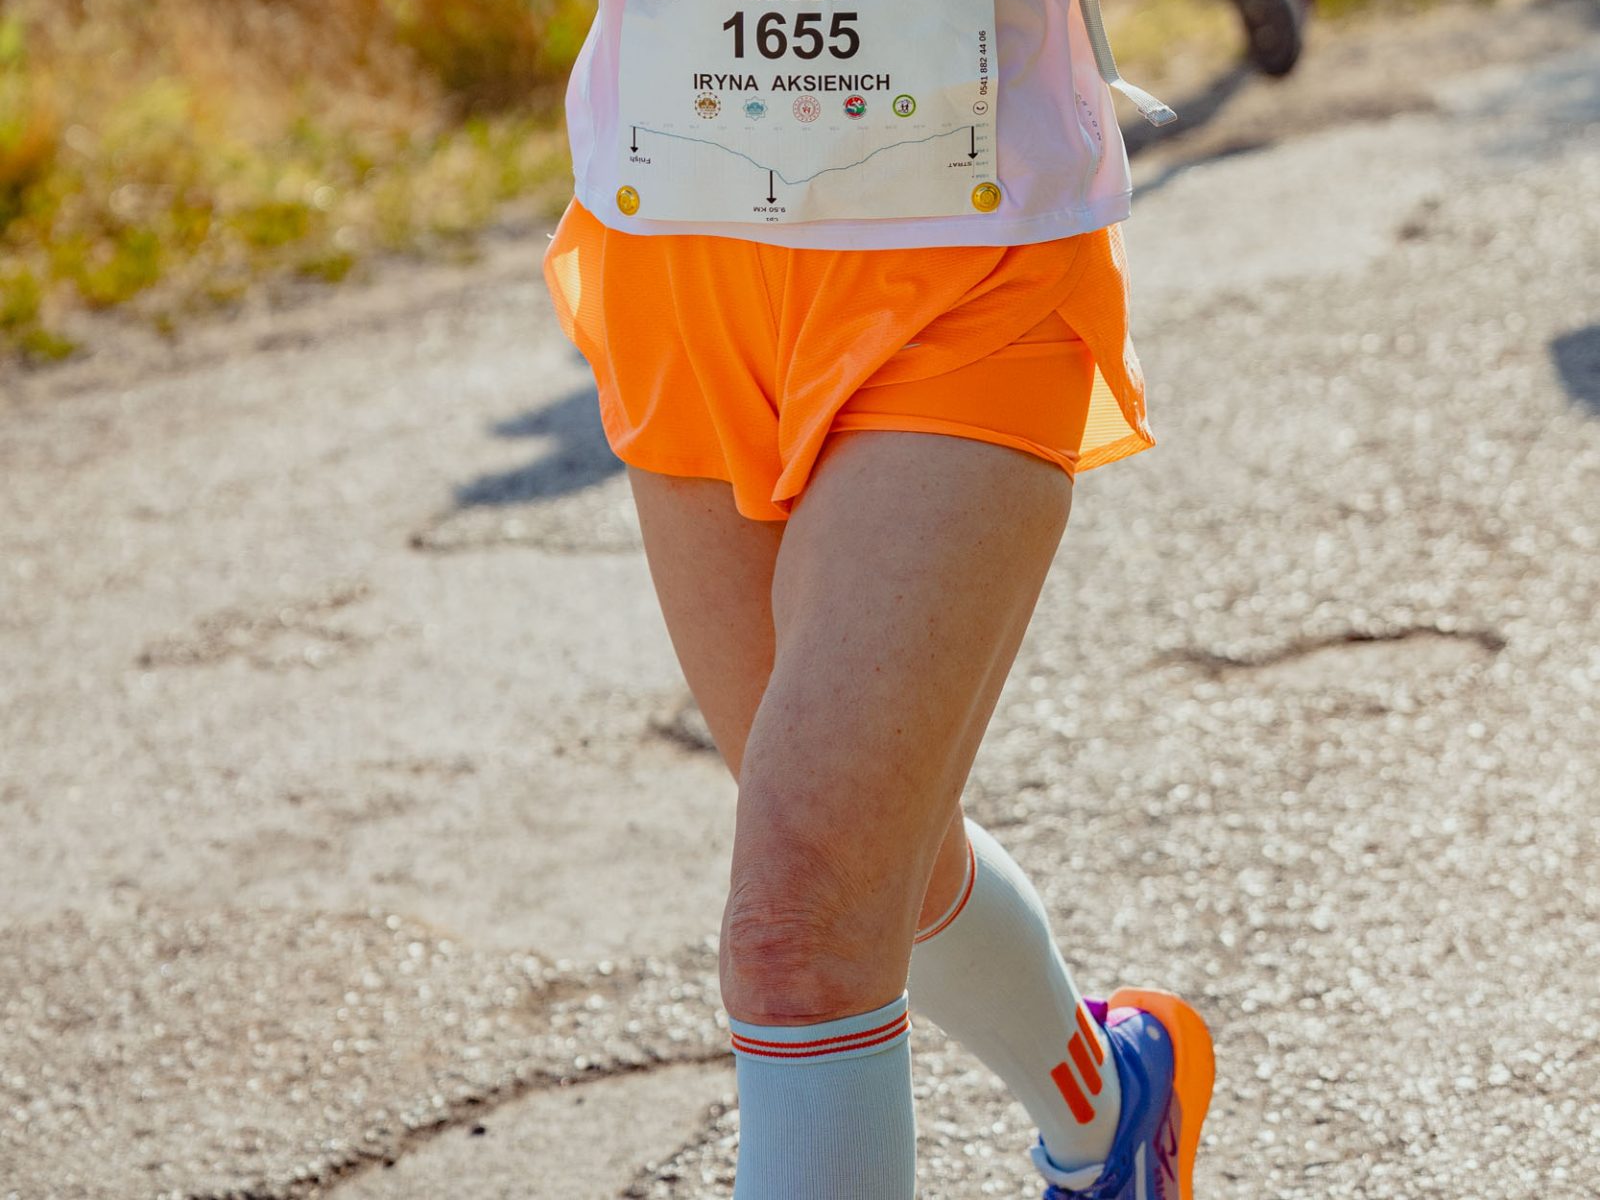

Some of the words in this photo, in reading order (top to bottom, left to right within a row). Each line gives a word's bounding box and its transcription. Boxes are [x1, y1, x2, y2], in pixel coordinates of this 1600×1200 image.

[723, 11, 860, 60] 1655
[979, 30, 986, 42] 06
[979, 44, 987, 55] 44
[980, 57, 988, 73] 882
[693, 73, 759, 91] IRYNA
[771, 74, 890, 92] AKSIENICH
[980, 76, 988, 95] 0541
